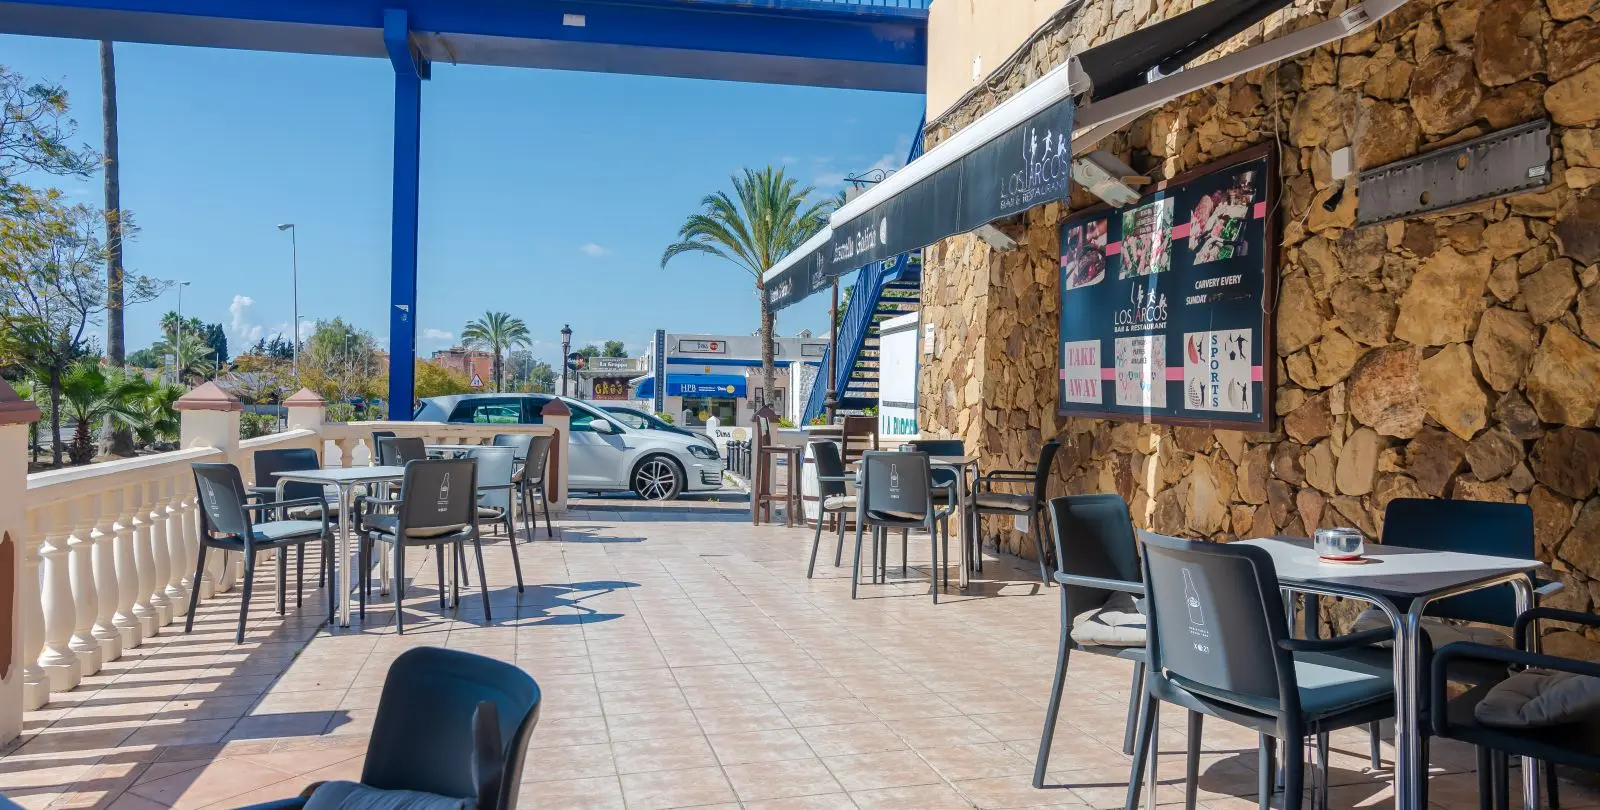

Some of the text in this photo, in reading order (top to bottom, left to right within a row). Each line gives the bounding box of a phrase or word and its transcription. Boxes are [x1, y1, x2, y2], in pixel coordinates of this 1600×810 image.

[1000, 154, 1068, 199] LOS ARCOS
[1195, 274, 1242, 289] CARVERY EVERY
[1186, 294, 1207, 305] SUNDAY
[1114, 305, 1168, 325] LOS ARCOS
[1130, 322, 1167, 331] RESTAURANT
[1068, 347, 1096, 366] TAKE
[1210, 335, 1220, 408] SPORTS
[680, 383, 697, 393] HPB
[1068, 378, 1098, 397] AWAY
